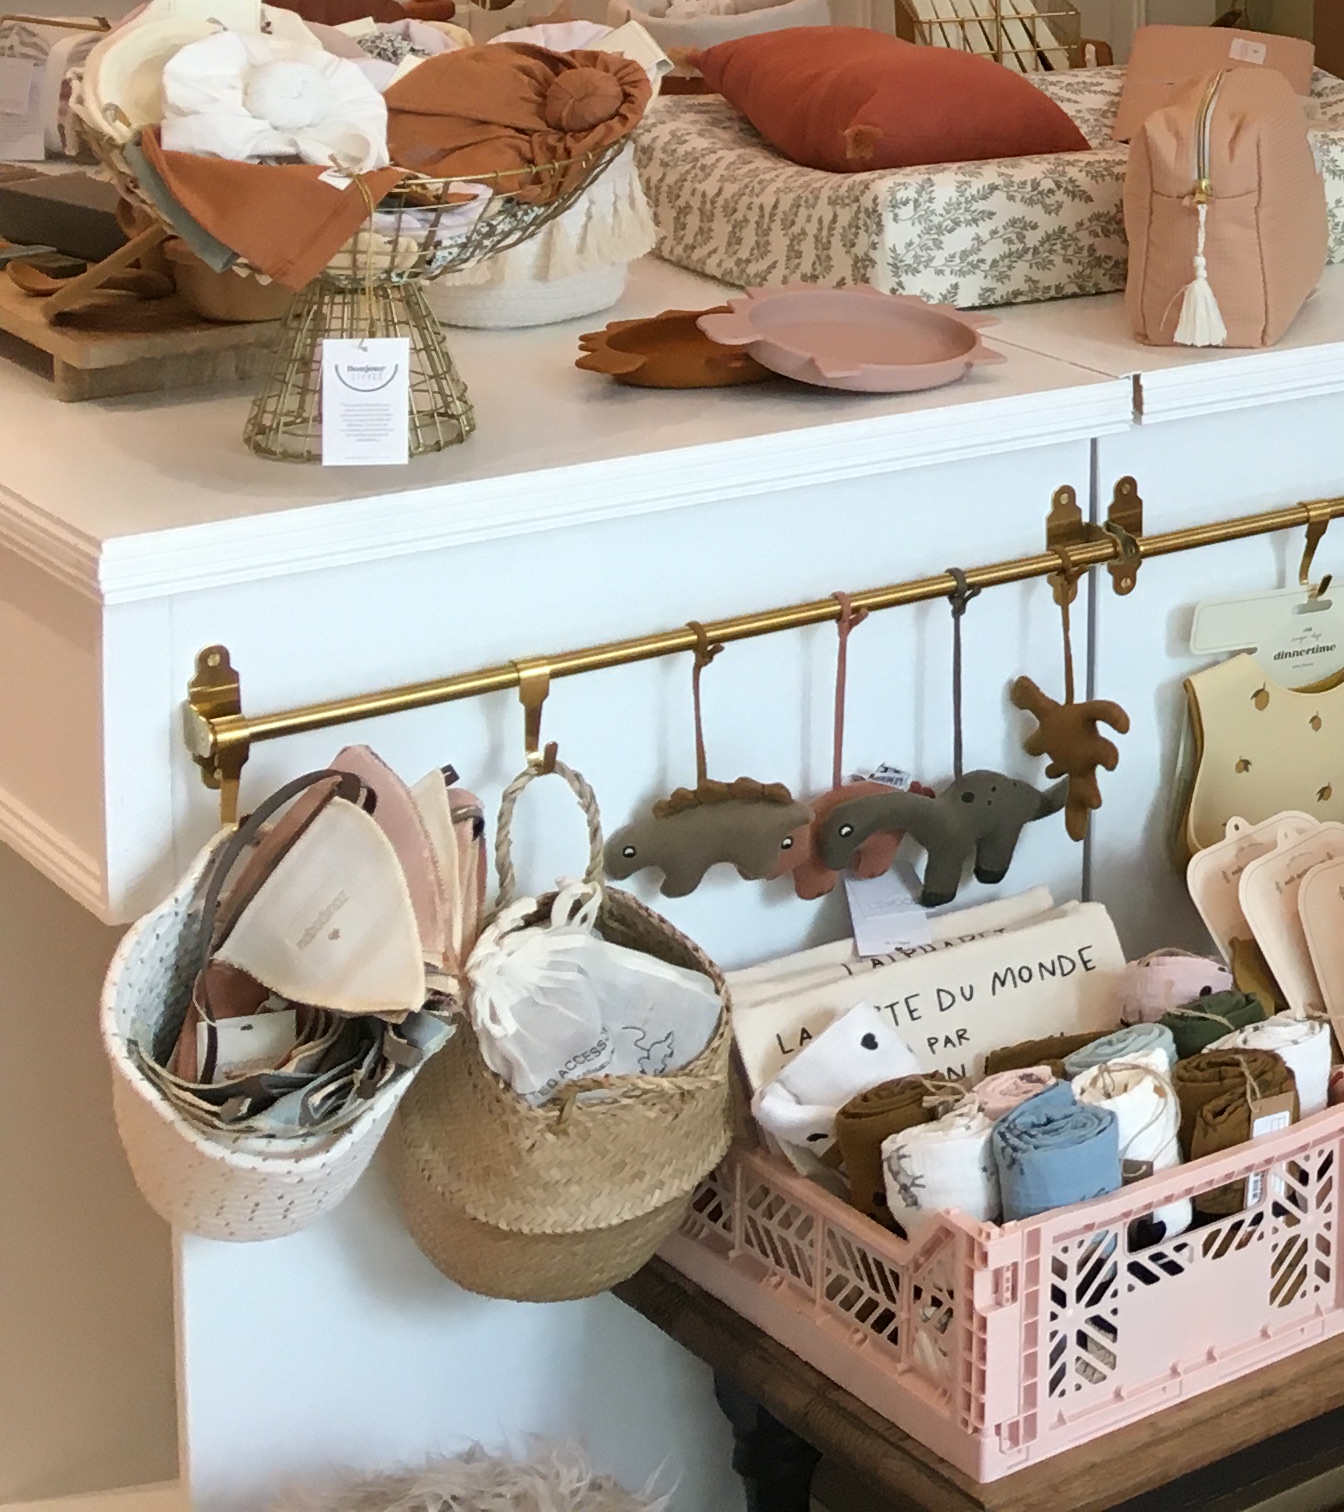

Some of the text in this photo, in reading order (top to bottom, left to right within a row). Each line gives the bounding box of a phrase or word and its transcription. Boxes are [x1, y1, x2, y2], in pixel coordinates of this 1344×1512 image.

[1273, 643, 1337, 661] dinnertime
[775, 1026, 813, 1055] LA
[936, 984, 975, 1013] DU
[991, 945, 1097, 996] MONDE
[926, 1028, 970, 1055] PAR
